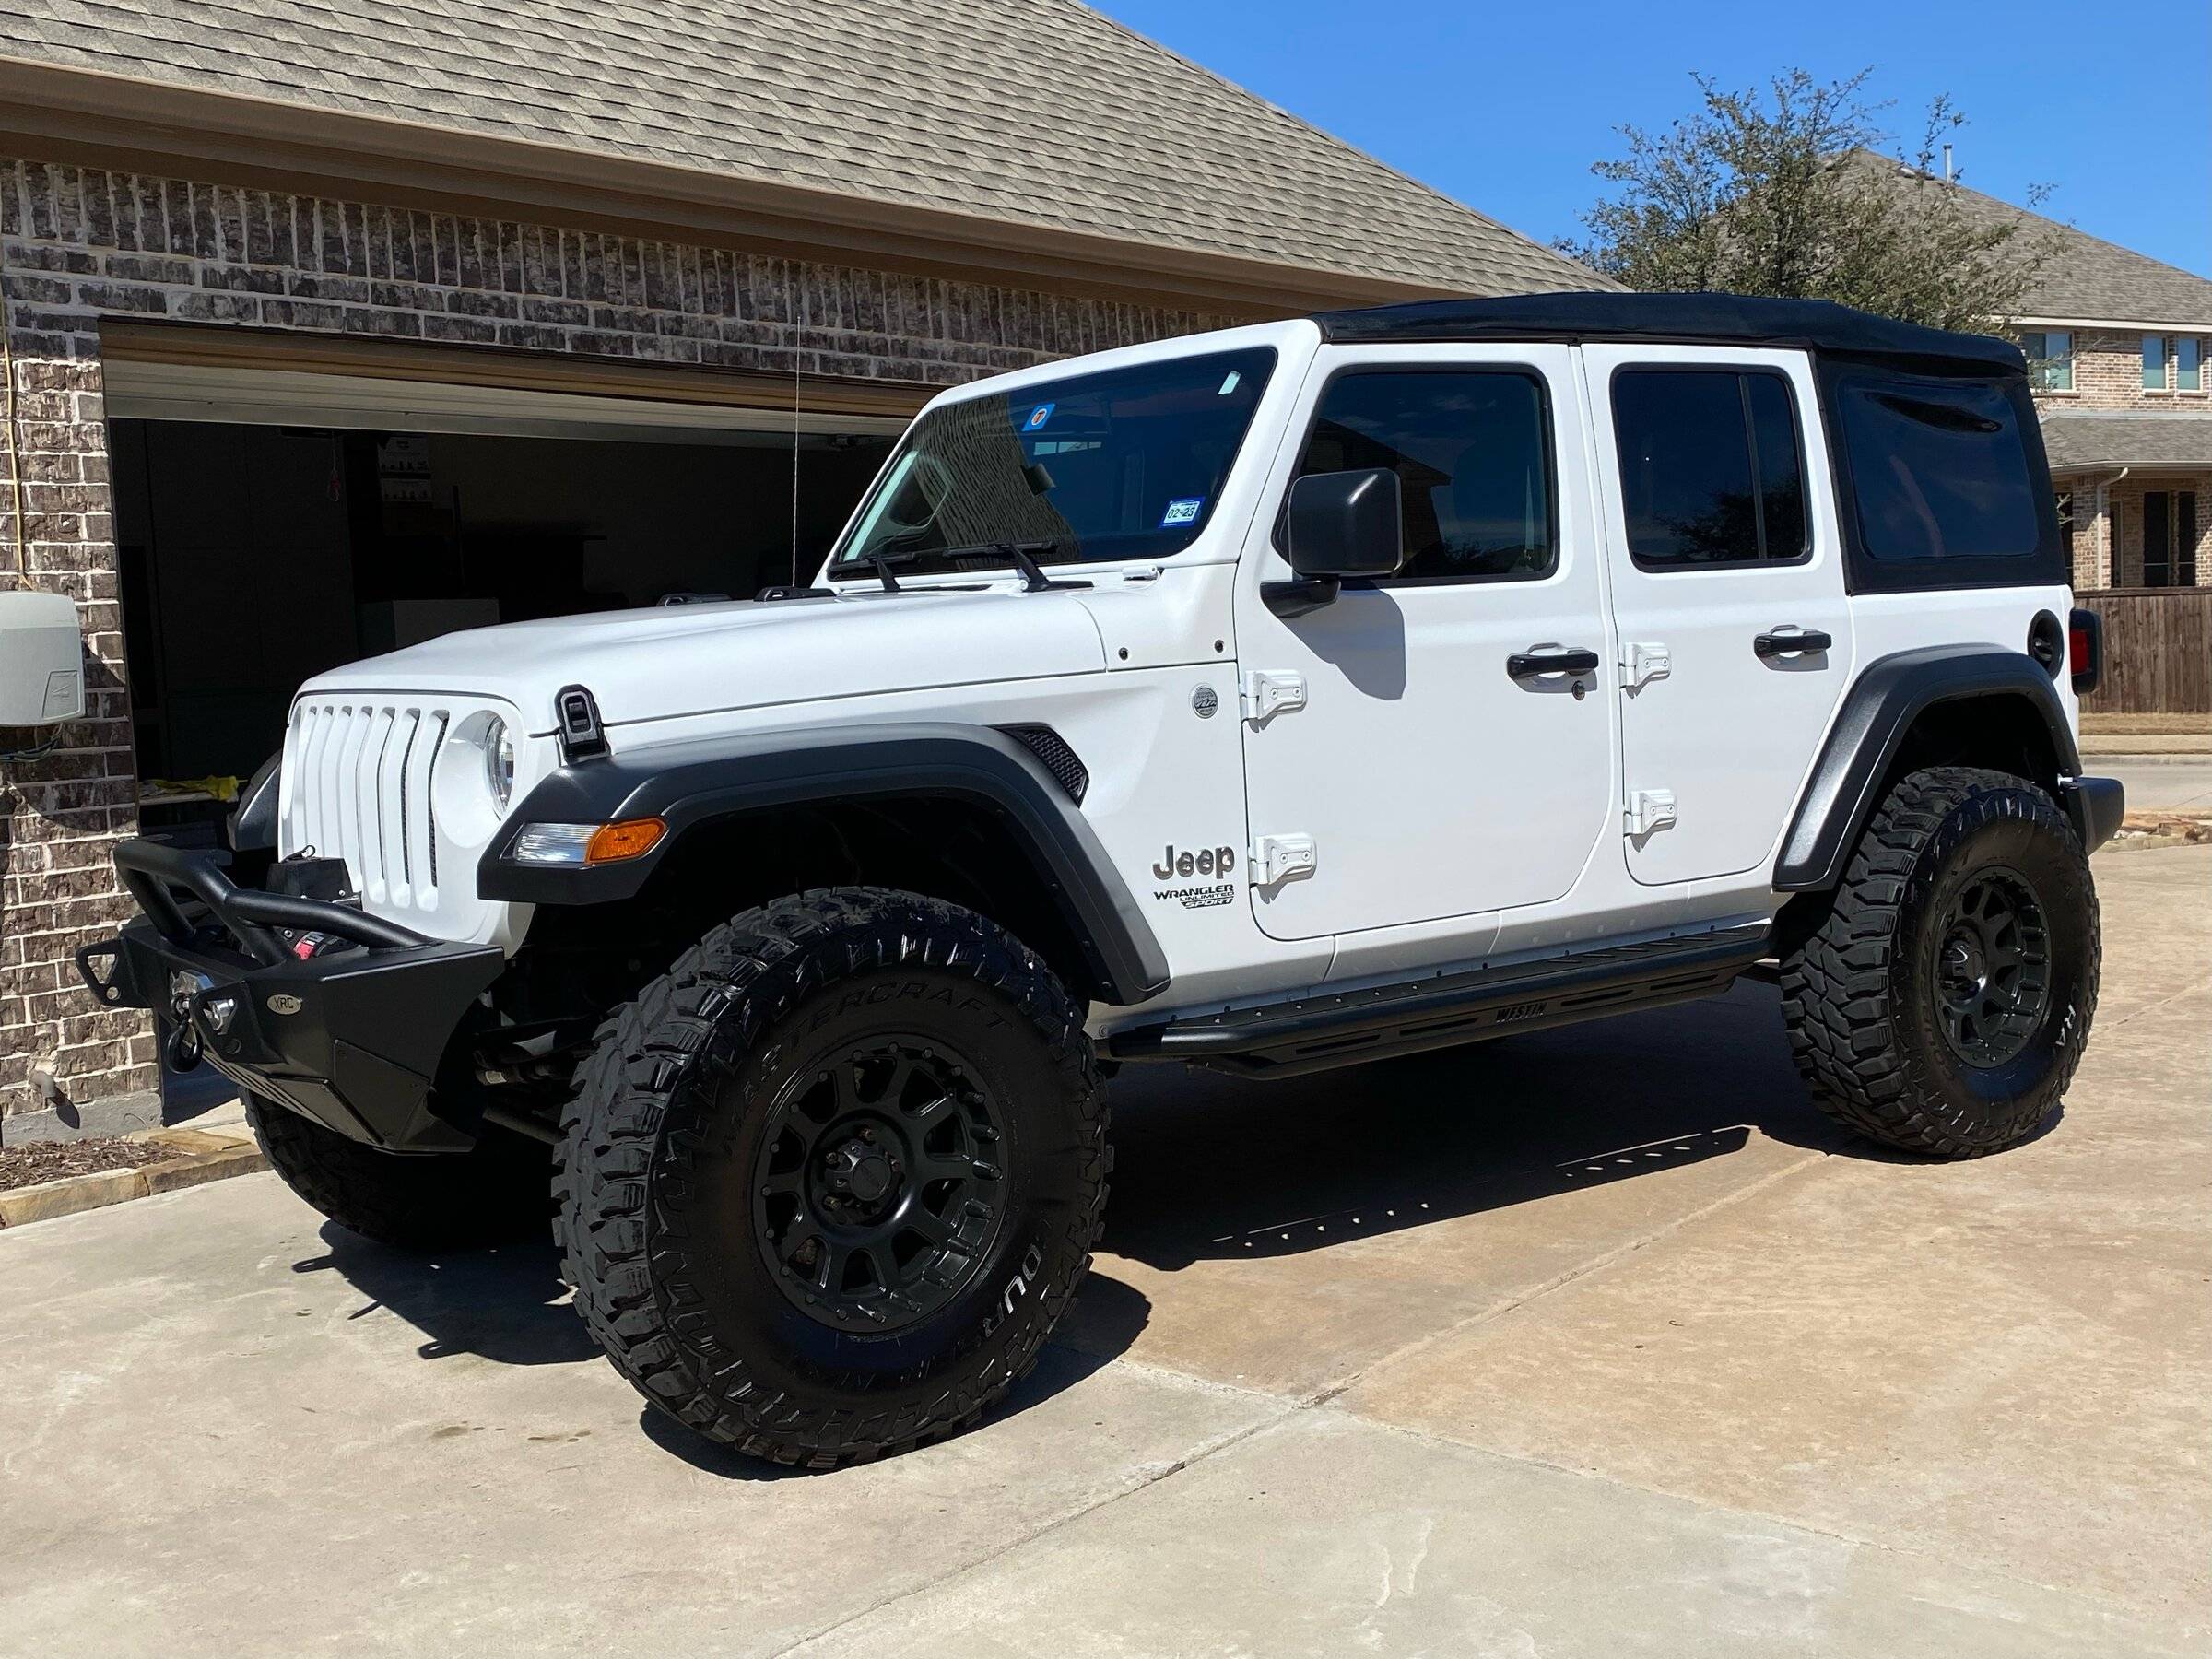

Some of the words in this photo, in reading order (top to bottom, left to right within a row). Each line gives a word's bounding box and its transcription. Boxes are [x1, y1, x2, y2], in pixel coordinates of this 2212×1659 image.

[1152, 845, 1235, 880] Jeep
[1153, 884, 1234, 900] WRANGLER
[1180, 891, 1235, 902] UNLIMITED
[1182, 897, 1234, 909] SPORT
[274, 996, 294, 1010] XRC
[1496, 1002, 1548, 1022] WESTIN
